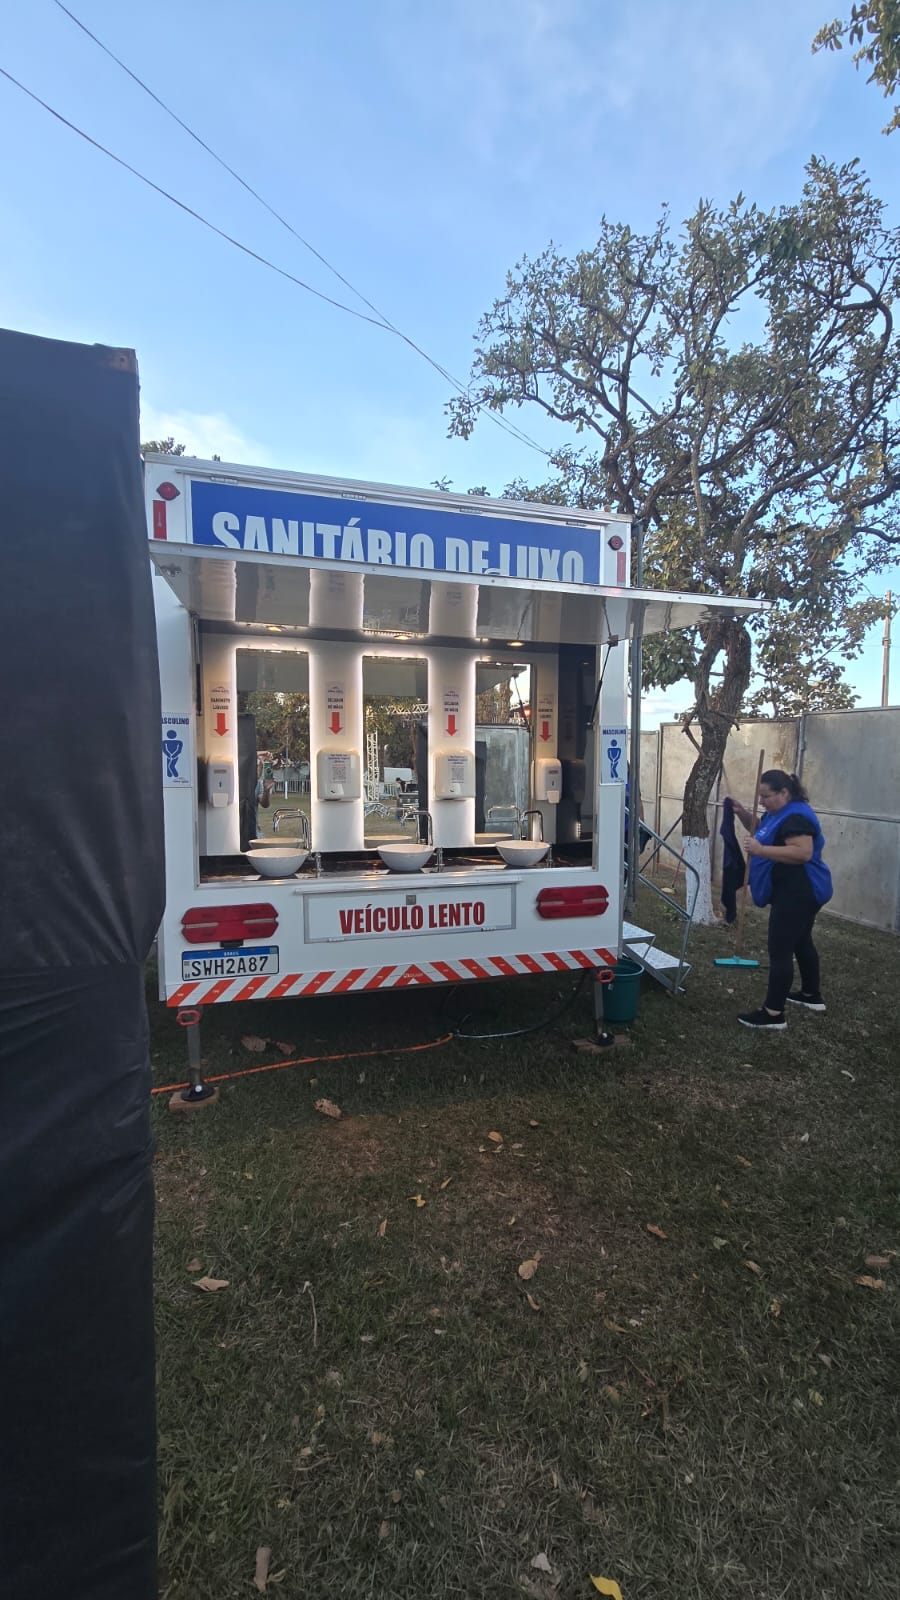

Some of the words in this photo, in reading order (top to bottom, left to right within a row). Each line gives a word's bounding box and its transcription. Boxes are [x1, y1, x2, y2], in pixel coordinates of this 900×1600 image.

[212, 511, 435, 569] SANITÁRIO
[445, 537, 489, 573] DE
[339, 904, 424, 934] VEÍCULO
[428, 902, 485, 928] LENTO
[192, 956, 268, 976] SWH2A87
